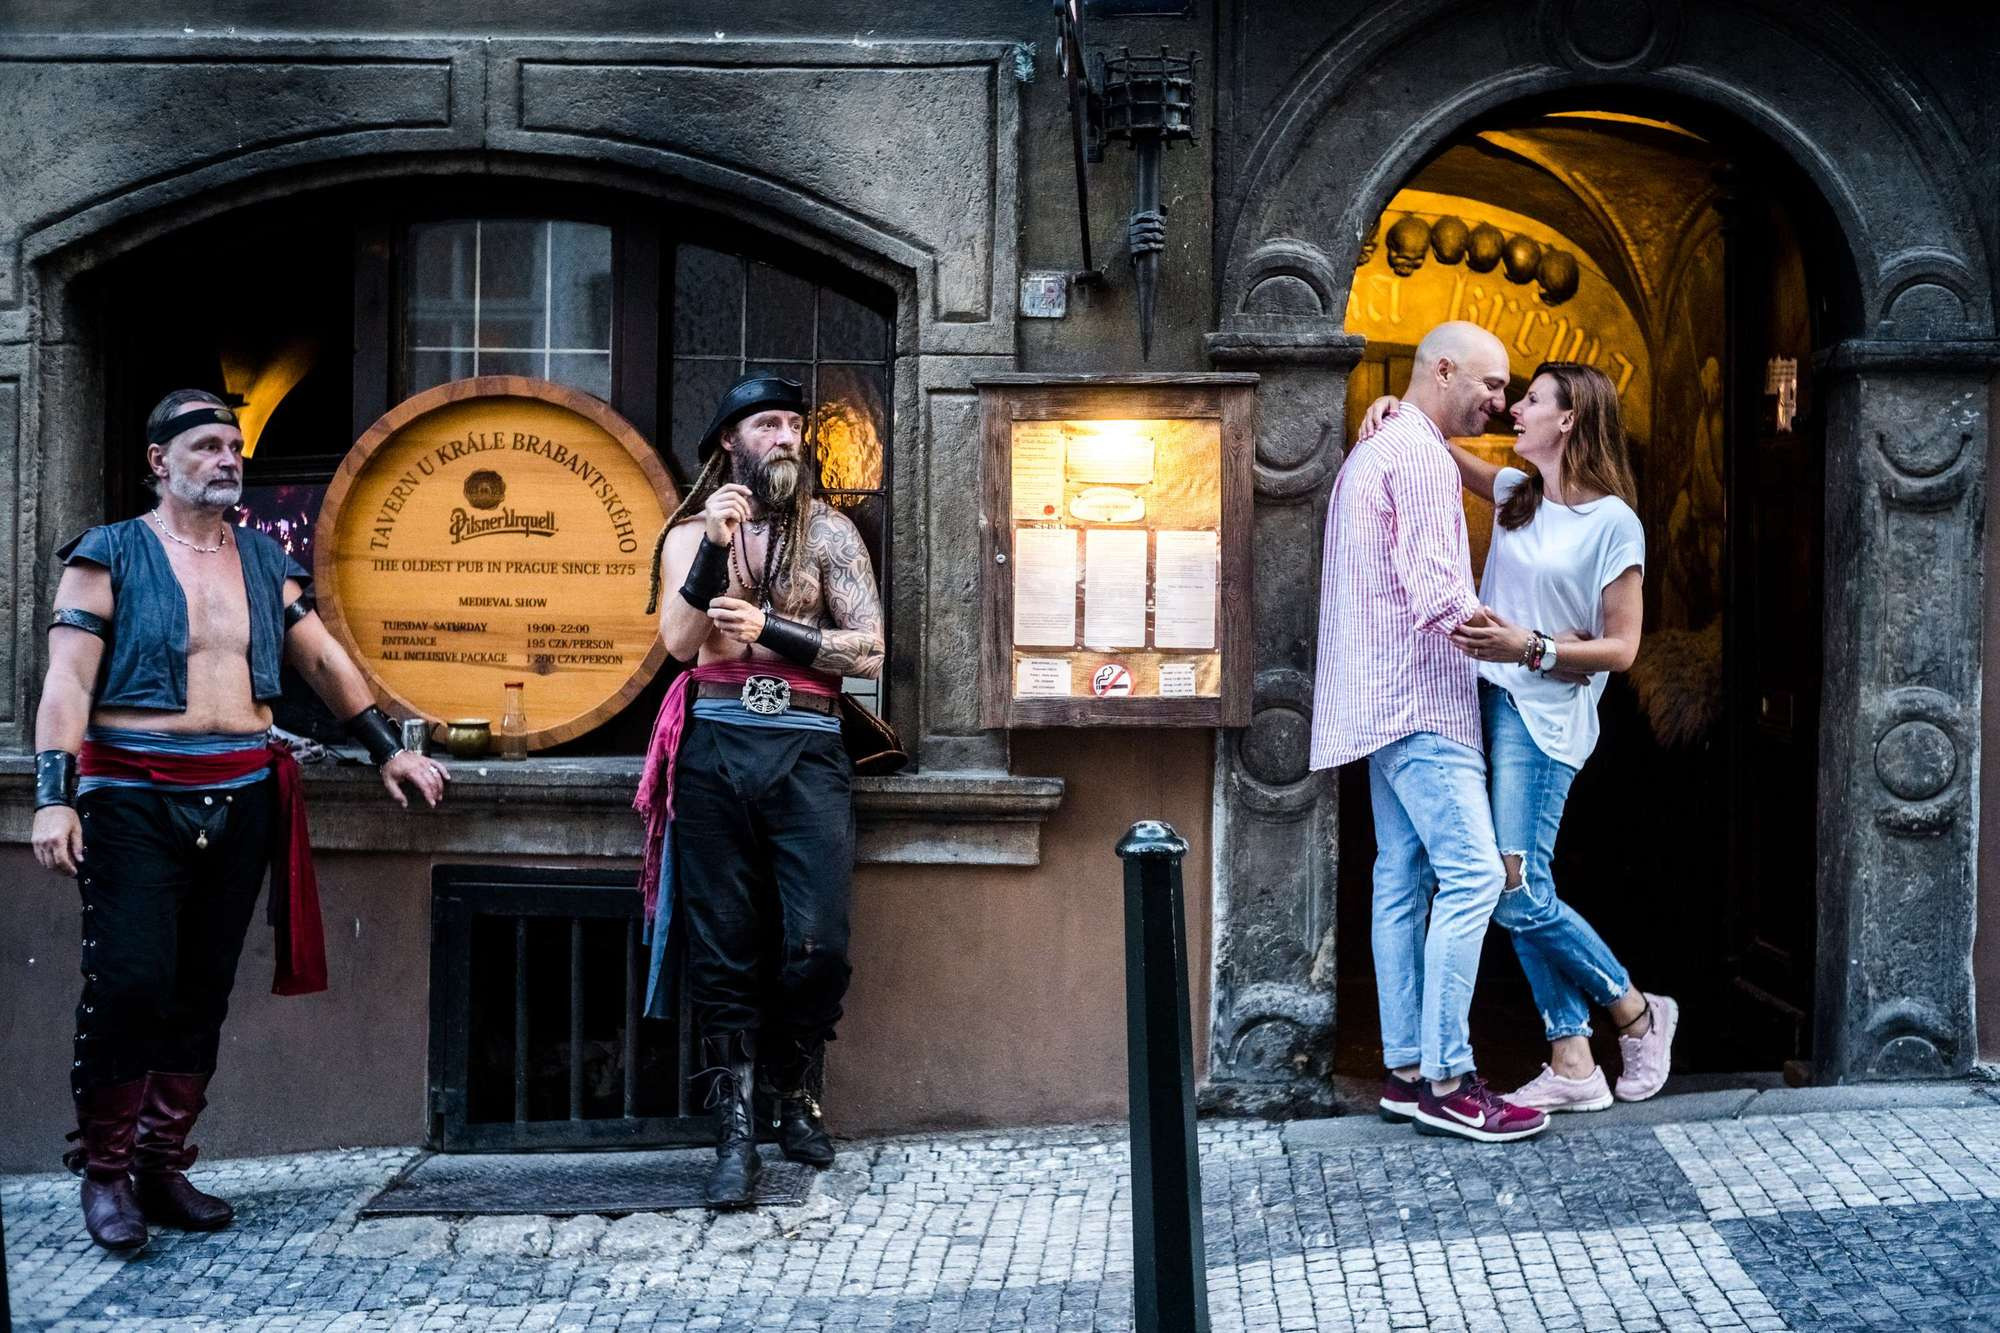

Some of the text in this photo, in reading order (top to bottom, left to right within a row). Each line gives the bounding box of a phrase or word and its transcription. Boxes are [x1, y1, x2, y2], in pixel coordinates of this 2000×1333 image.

[369, 471, 421, 551] TAVERN
[416, 456, 435, 476] U
[435, 431, 506, 466] KRÁLE
[511, 432, 638, 554] BRABANTSKÉHO
[449, 507, 504, 545] Pilsner
[371, 559, 637, 576] THE OLDEST PUB IN PRAGUE SINCE 1375
[458, 596, 548, 609] MEDIEVAL SHOW
[381, 635, 615, 650] ENTRANCE 195 CZK/PERSON
[381, 650, 401, 661] ALL
[403, 651, 458, 663] INCLUSIVE
[460, 652, 508, 663] PACKAGE
[557, 653, 624, 665] CZK/PERSON
